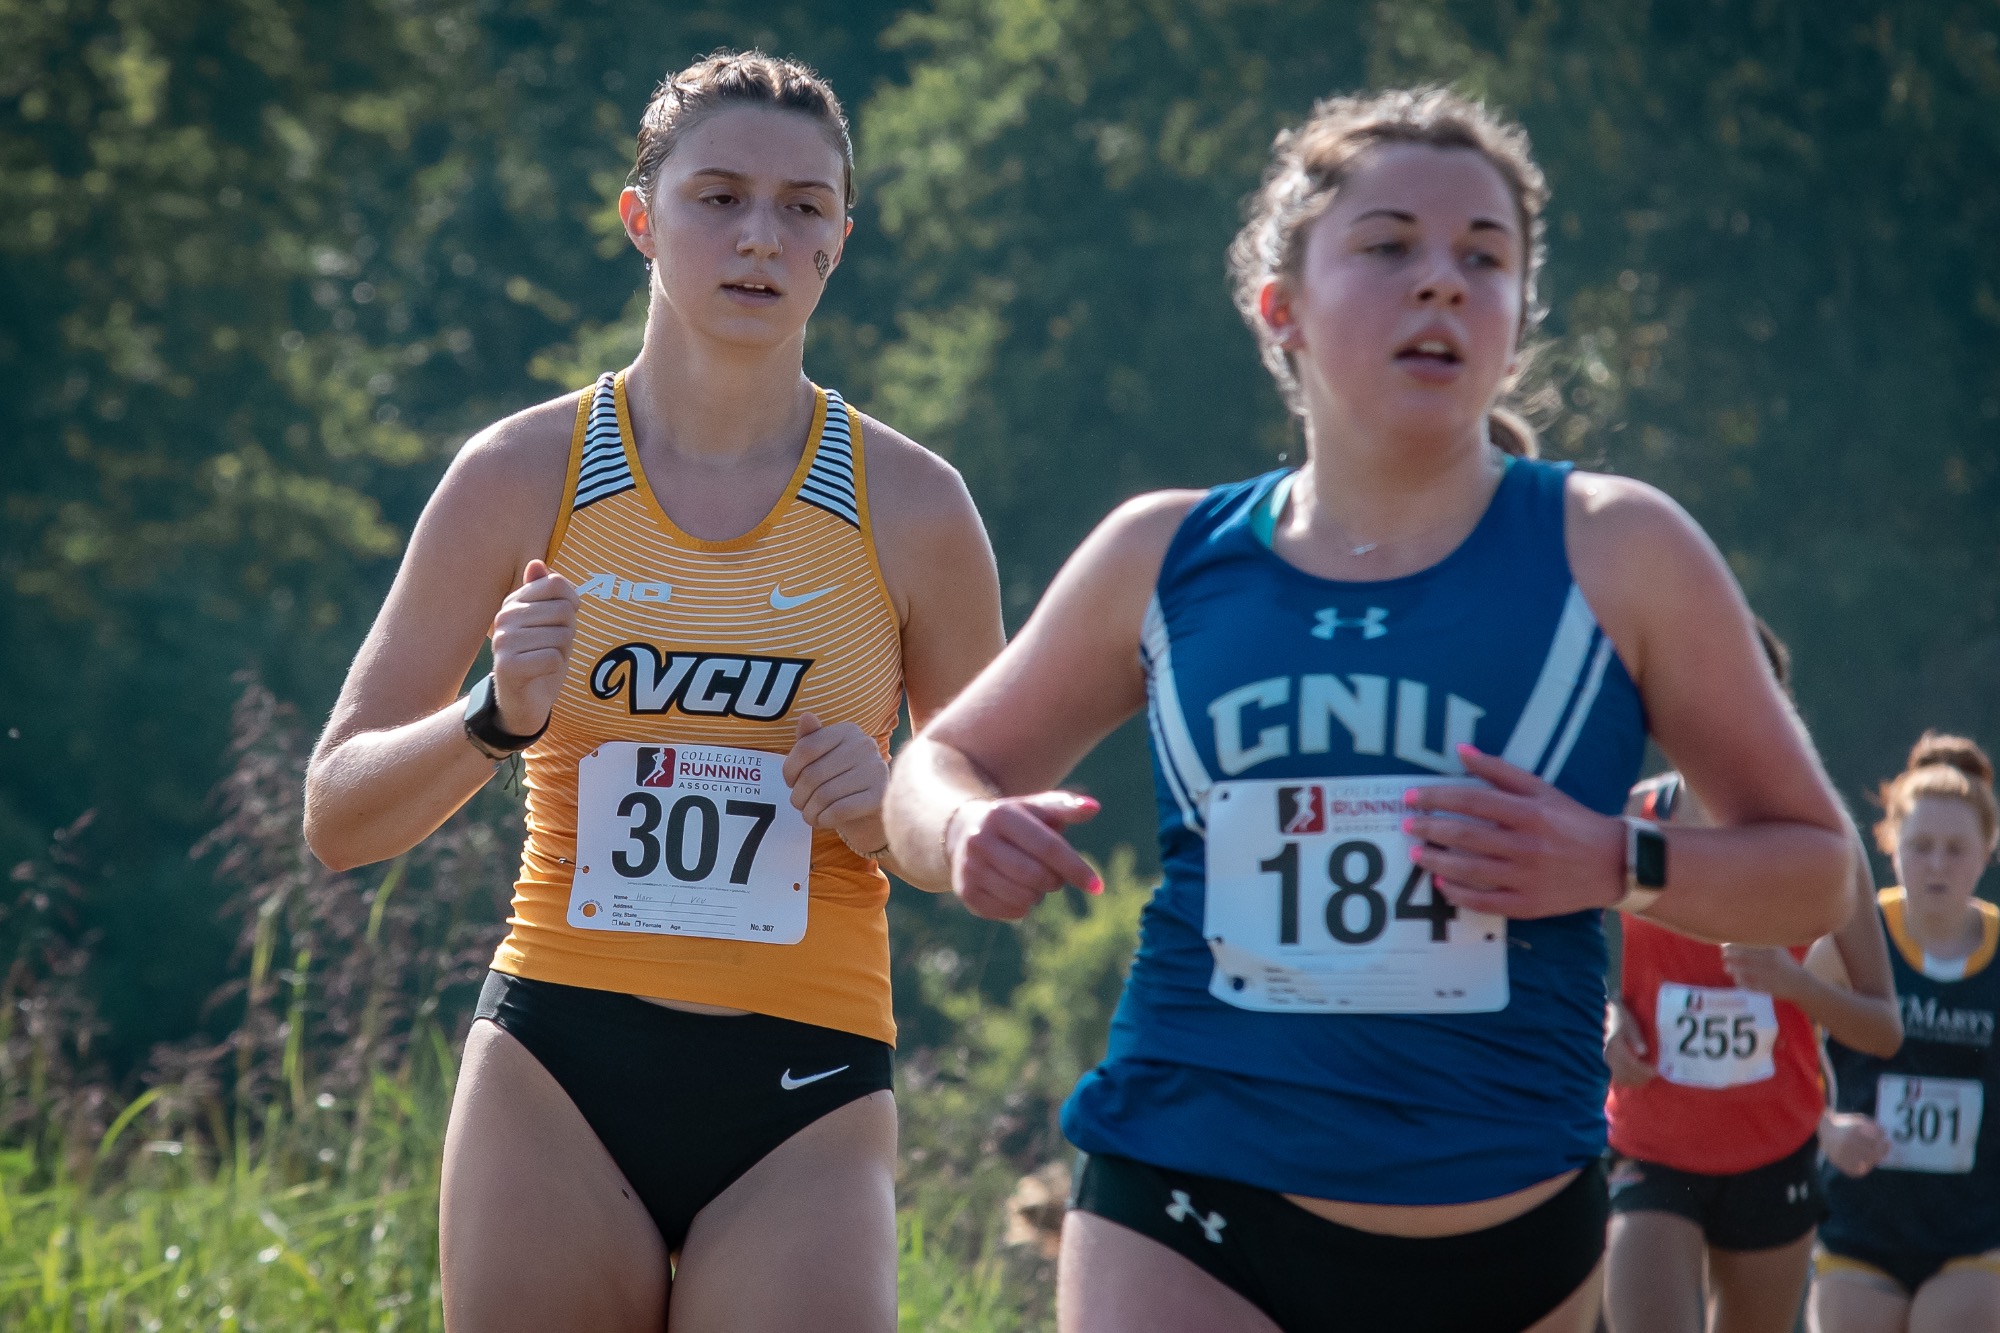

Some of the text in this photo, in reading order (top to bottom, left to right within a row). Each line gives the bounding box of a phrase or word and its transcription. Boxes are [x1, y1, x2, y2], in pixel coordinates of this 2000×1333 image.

[590, 642, 816, 722] VCU
[1207, 673, 1486, 776] CNU
[680, 762, 761, 782] RUNNING
[681, 751, 762, 766] COLLEGIATE
[678, 782, 761, 795] ASSOCIATION
[1331, 800, 1428, 815] RUNNI
[611, 792, 777, 885] 307
[1261, 841, 1458, 945] 184
[750, 923, 775, 932] No. 307
[1676, 1013, 1758, 1061] 255
[1892, 1102, 1962, 1146] 301
